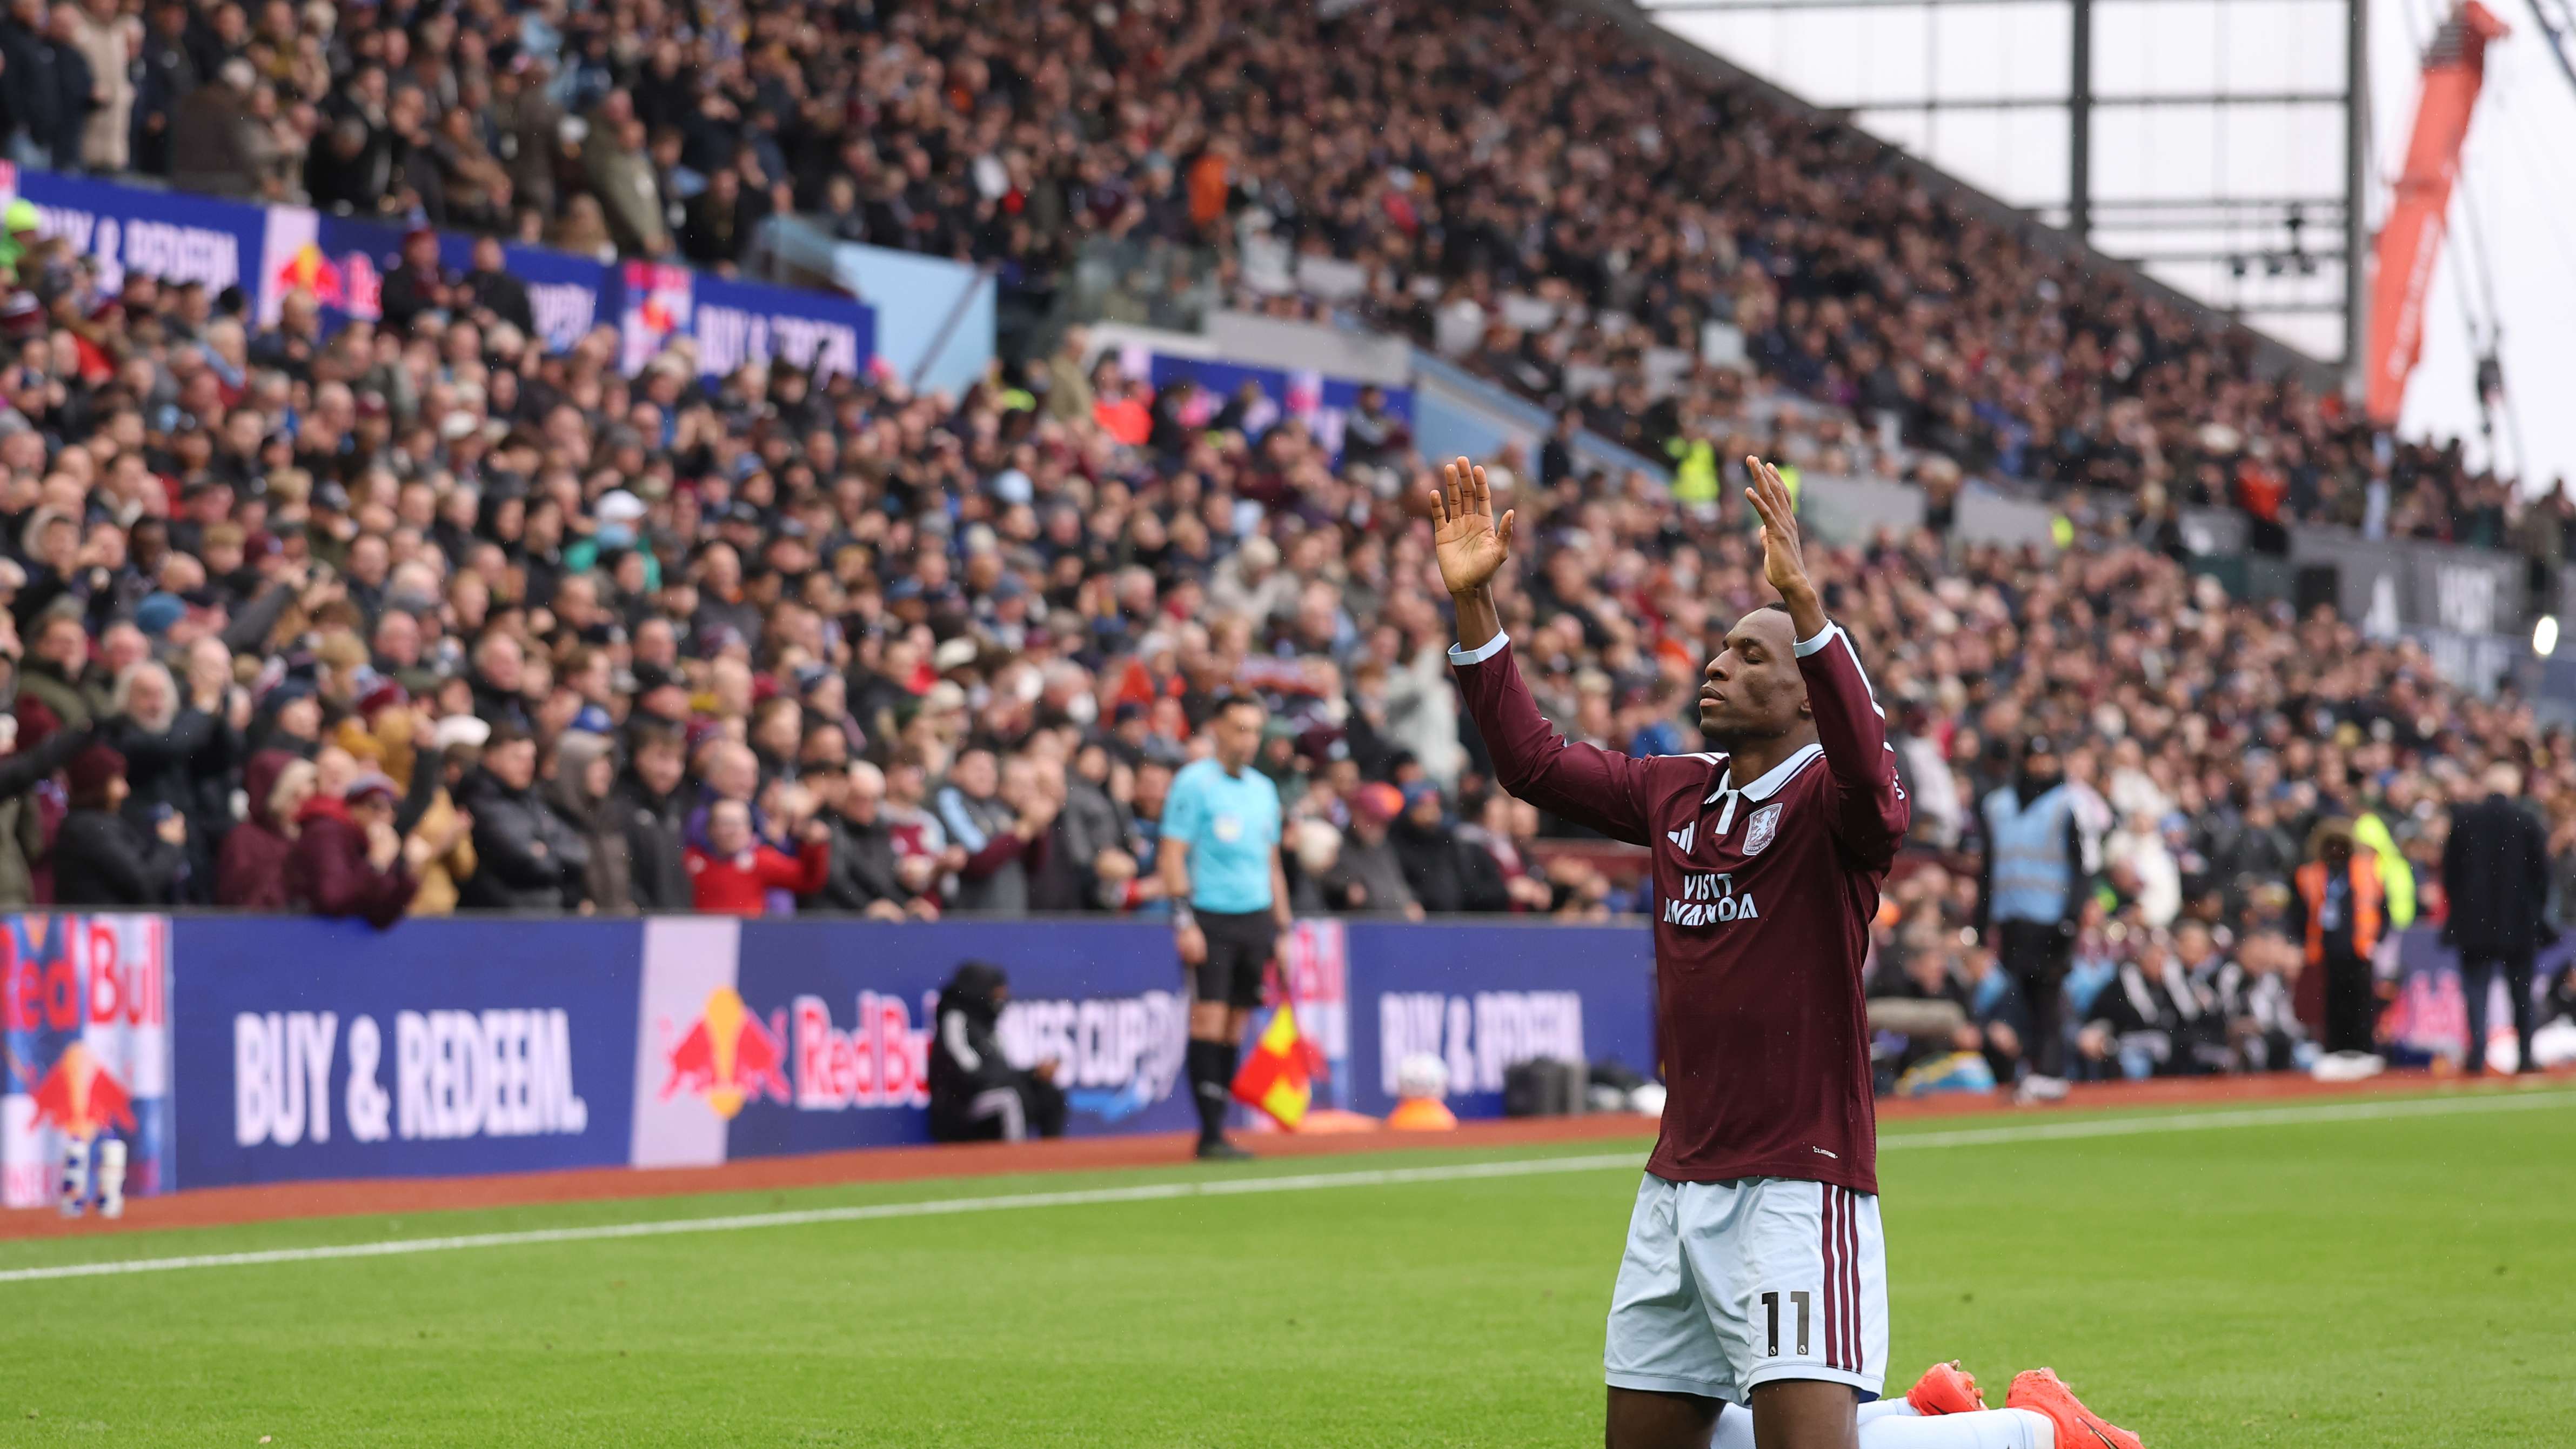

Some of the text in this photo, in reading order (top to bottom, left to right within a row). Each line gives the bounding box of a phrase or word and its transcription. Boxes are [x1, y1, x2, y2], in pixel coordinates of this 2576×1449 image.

[1663, 893, 1758, 926] RWANDA
[1684, 873, 1732, 900] VISIT
[90, 913, 165, 1027] Bull
[234, 1007, 589, 1147] BUY & REDEEM.
[1446, 994, 1474, 1094] &
[1761, 1291, 1810, 1357] 11
